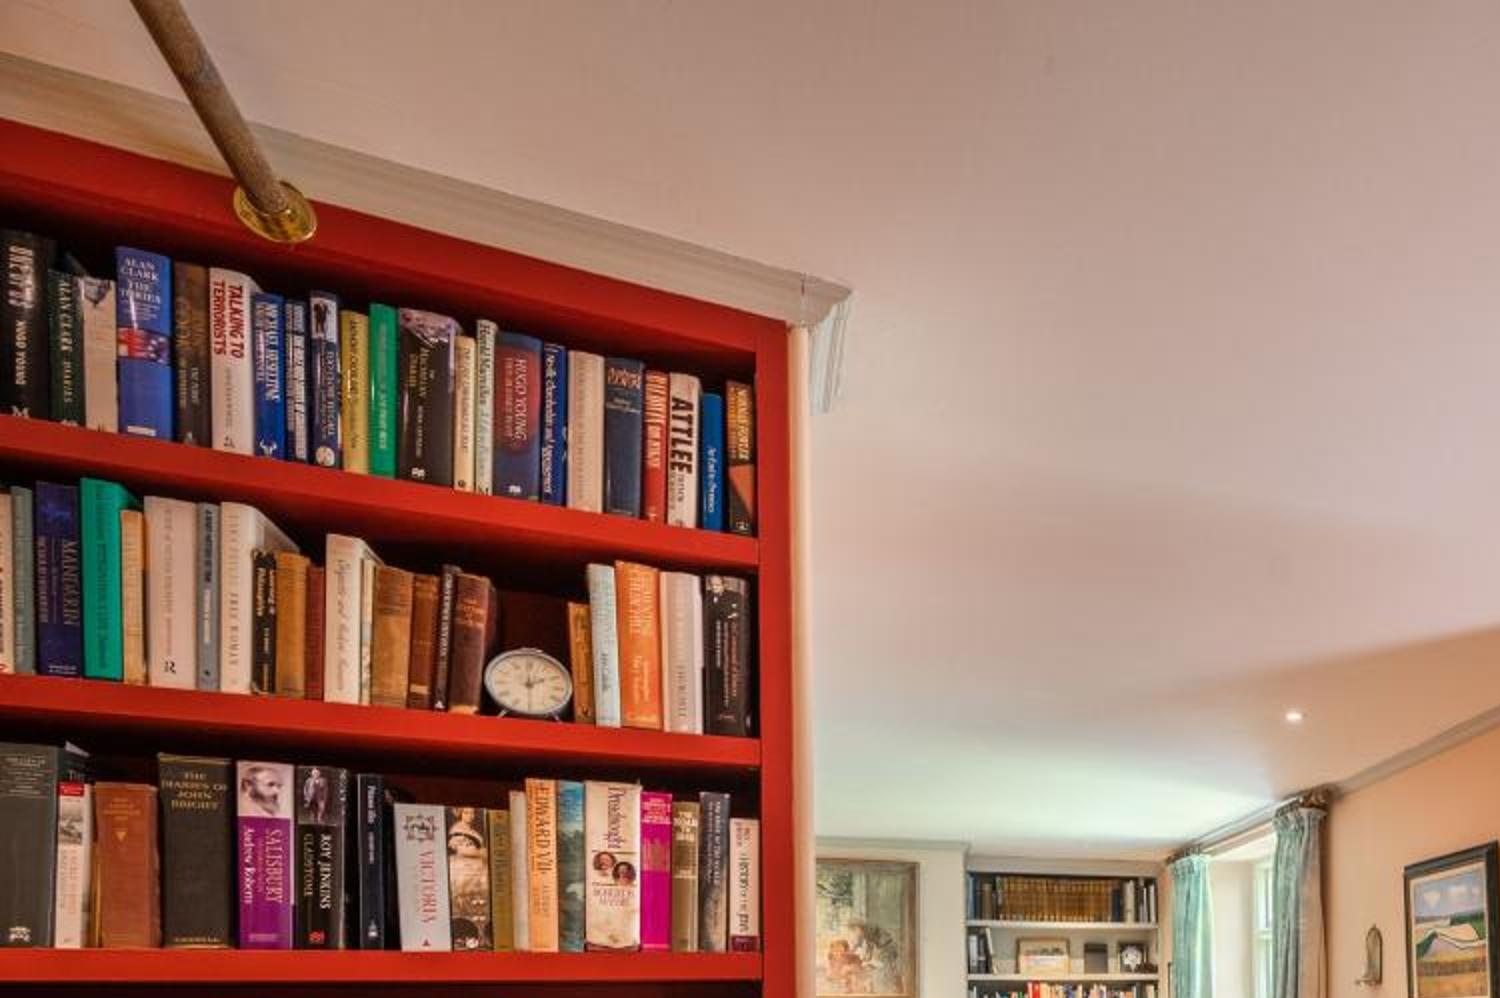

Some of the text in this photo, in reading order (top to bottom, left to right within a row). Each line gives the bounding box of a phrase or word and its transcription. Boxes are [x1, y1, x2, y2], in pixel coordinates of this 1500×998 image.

[213, 280, 227, 355] TERRORISTS
[229, 286, 244, 338] TALKING
[229, 342, 244, 359] TO
[670, 397, 694, 475] ATTLEE
[535, 786, 552, 849] EDWARD
[603, 787, 627, 849] Dreadnought
[265, 829, 283, 903] SALISBURY
[318, 833, 332, 909] ROY JENKINS
